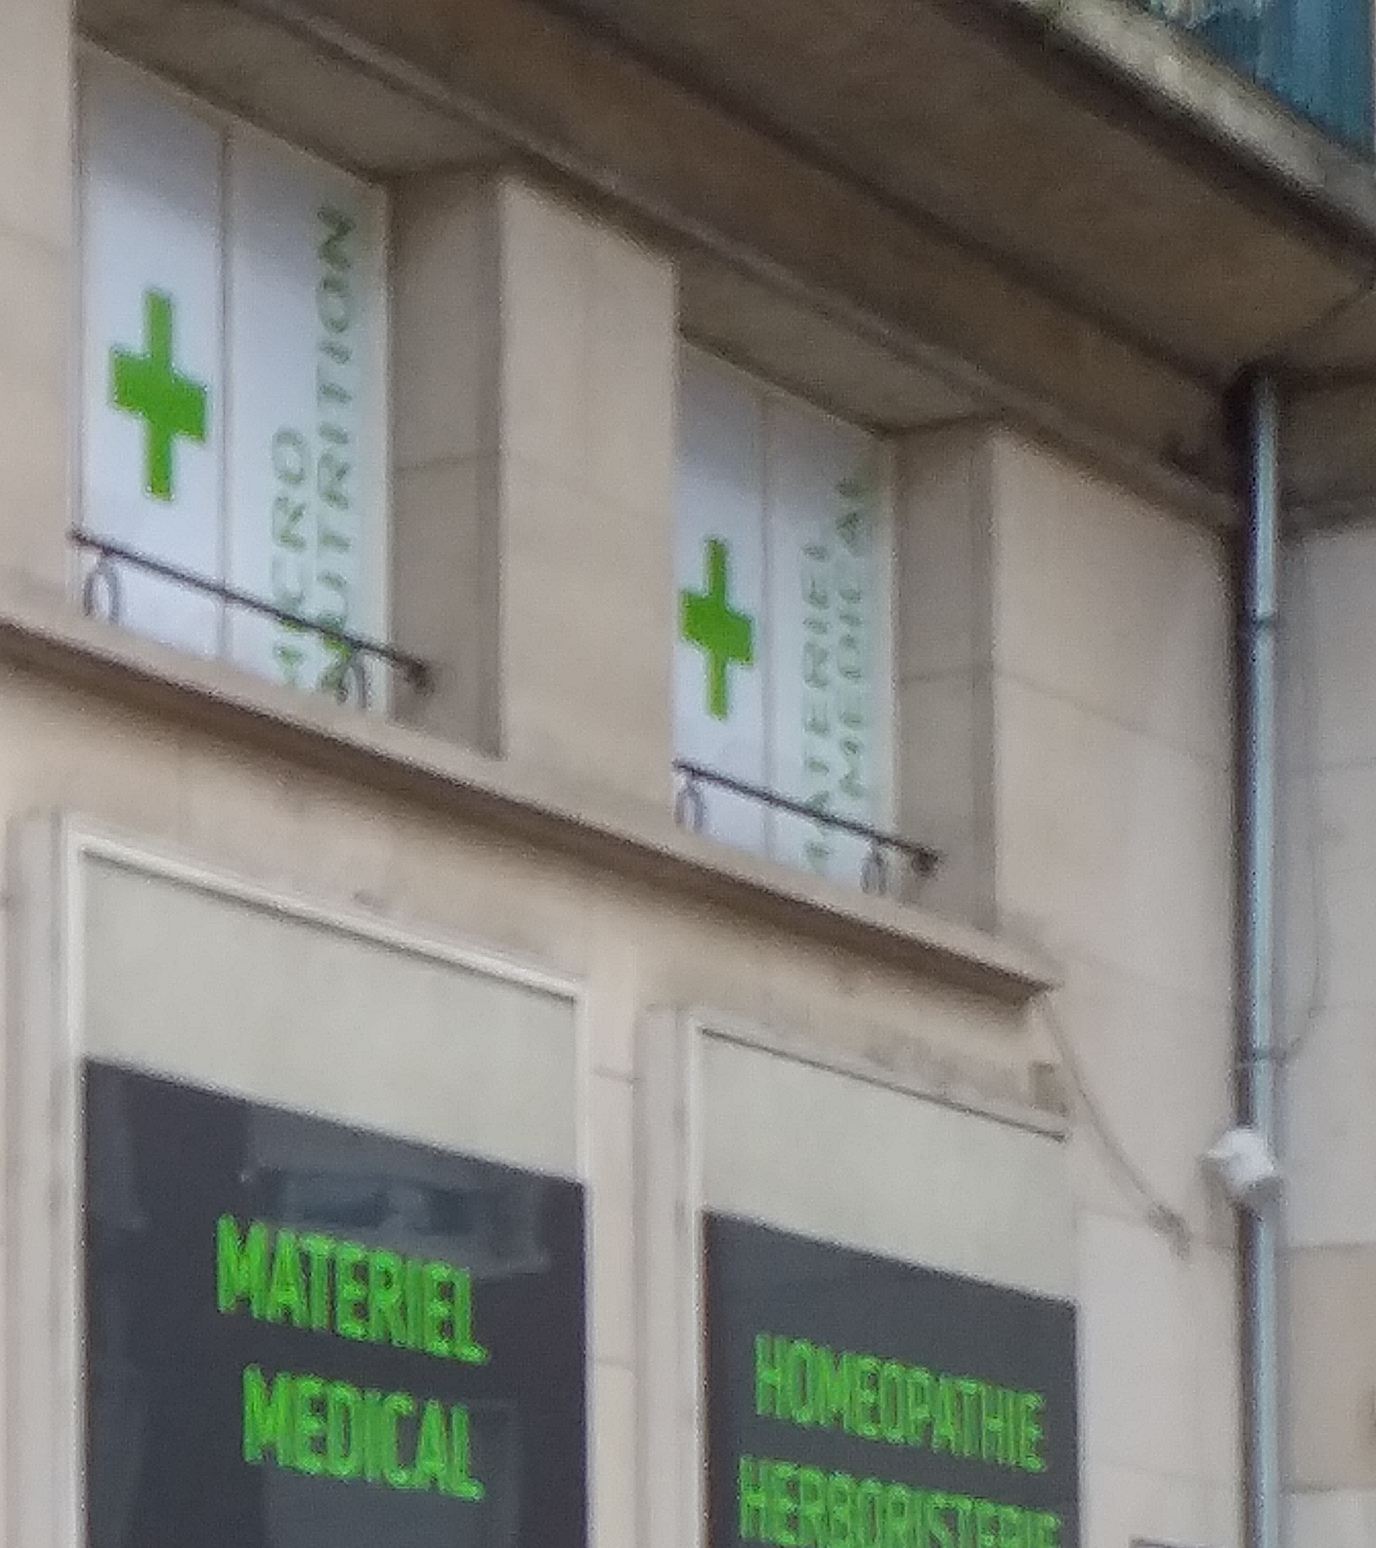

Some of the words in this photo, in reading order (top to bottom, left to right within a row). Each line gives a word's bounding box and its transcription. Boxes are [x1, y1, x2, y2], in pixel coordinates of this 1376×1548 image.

[215, 1212, 491, 1364] MATERIEL
[241, 1362, 487, 1501] MEDICAL
[754, 1333, 1048, 1474] HOMEOPATHIE
